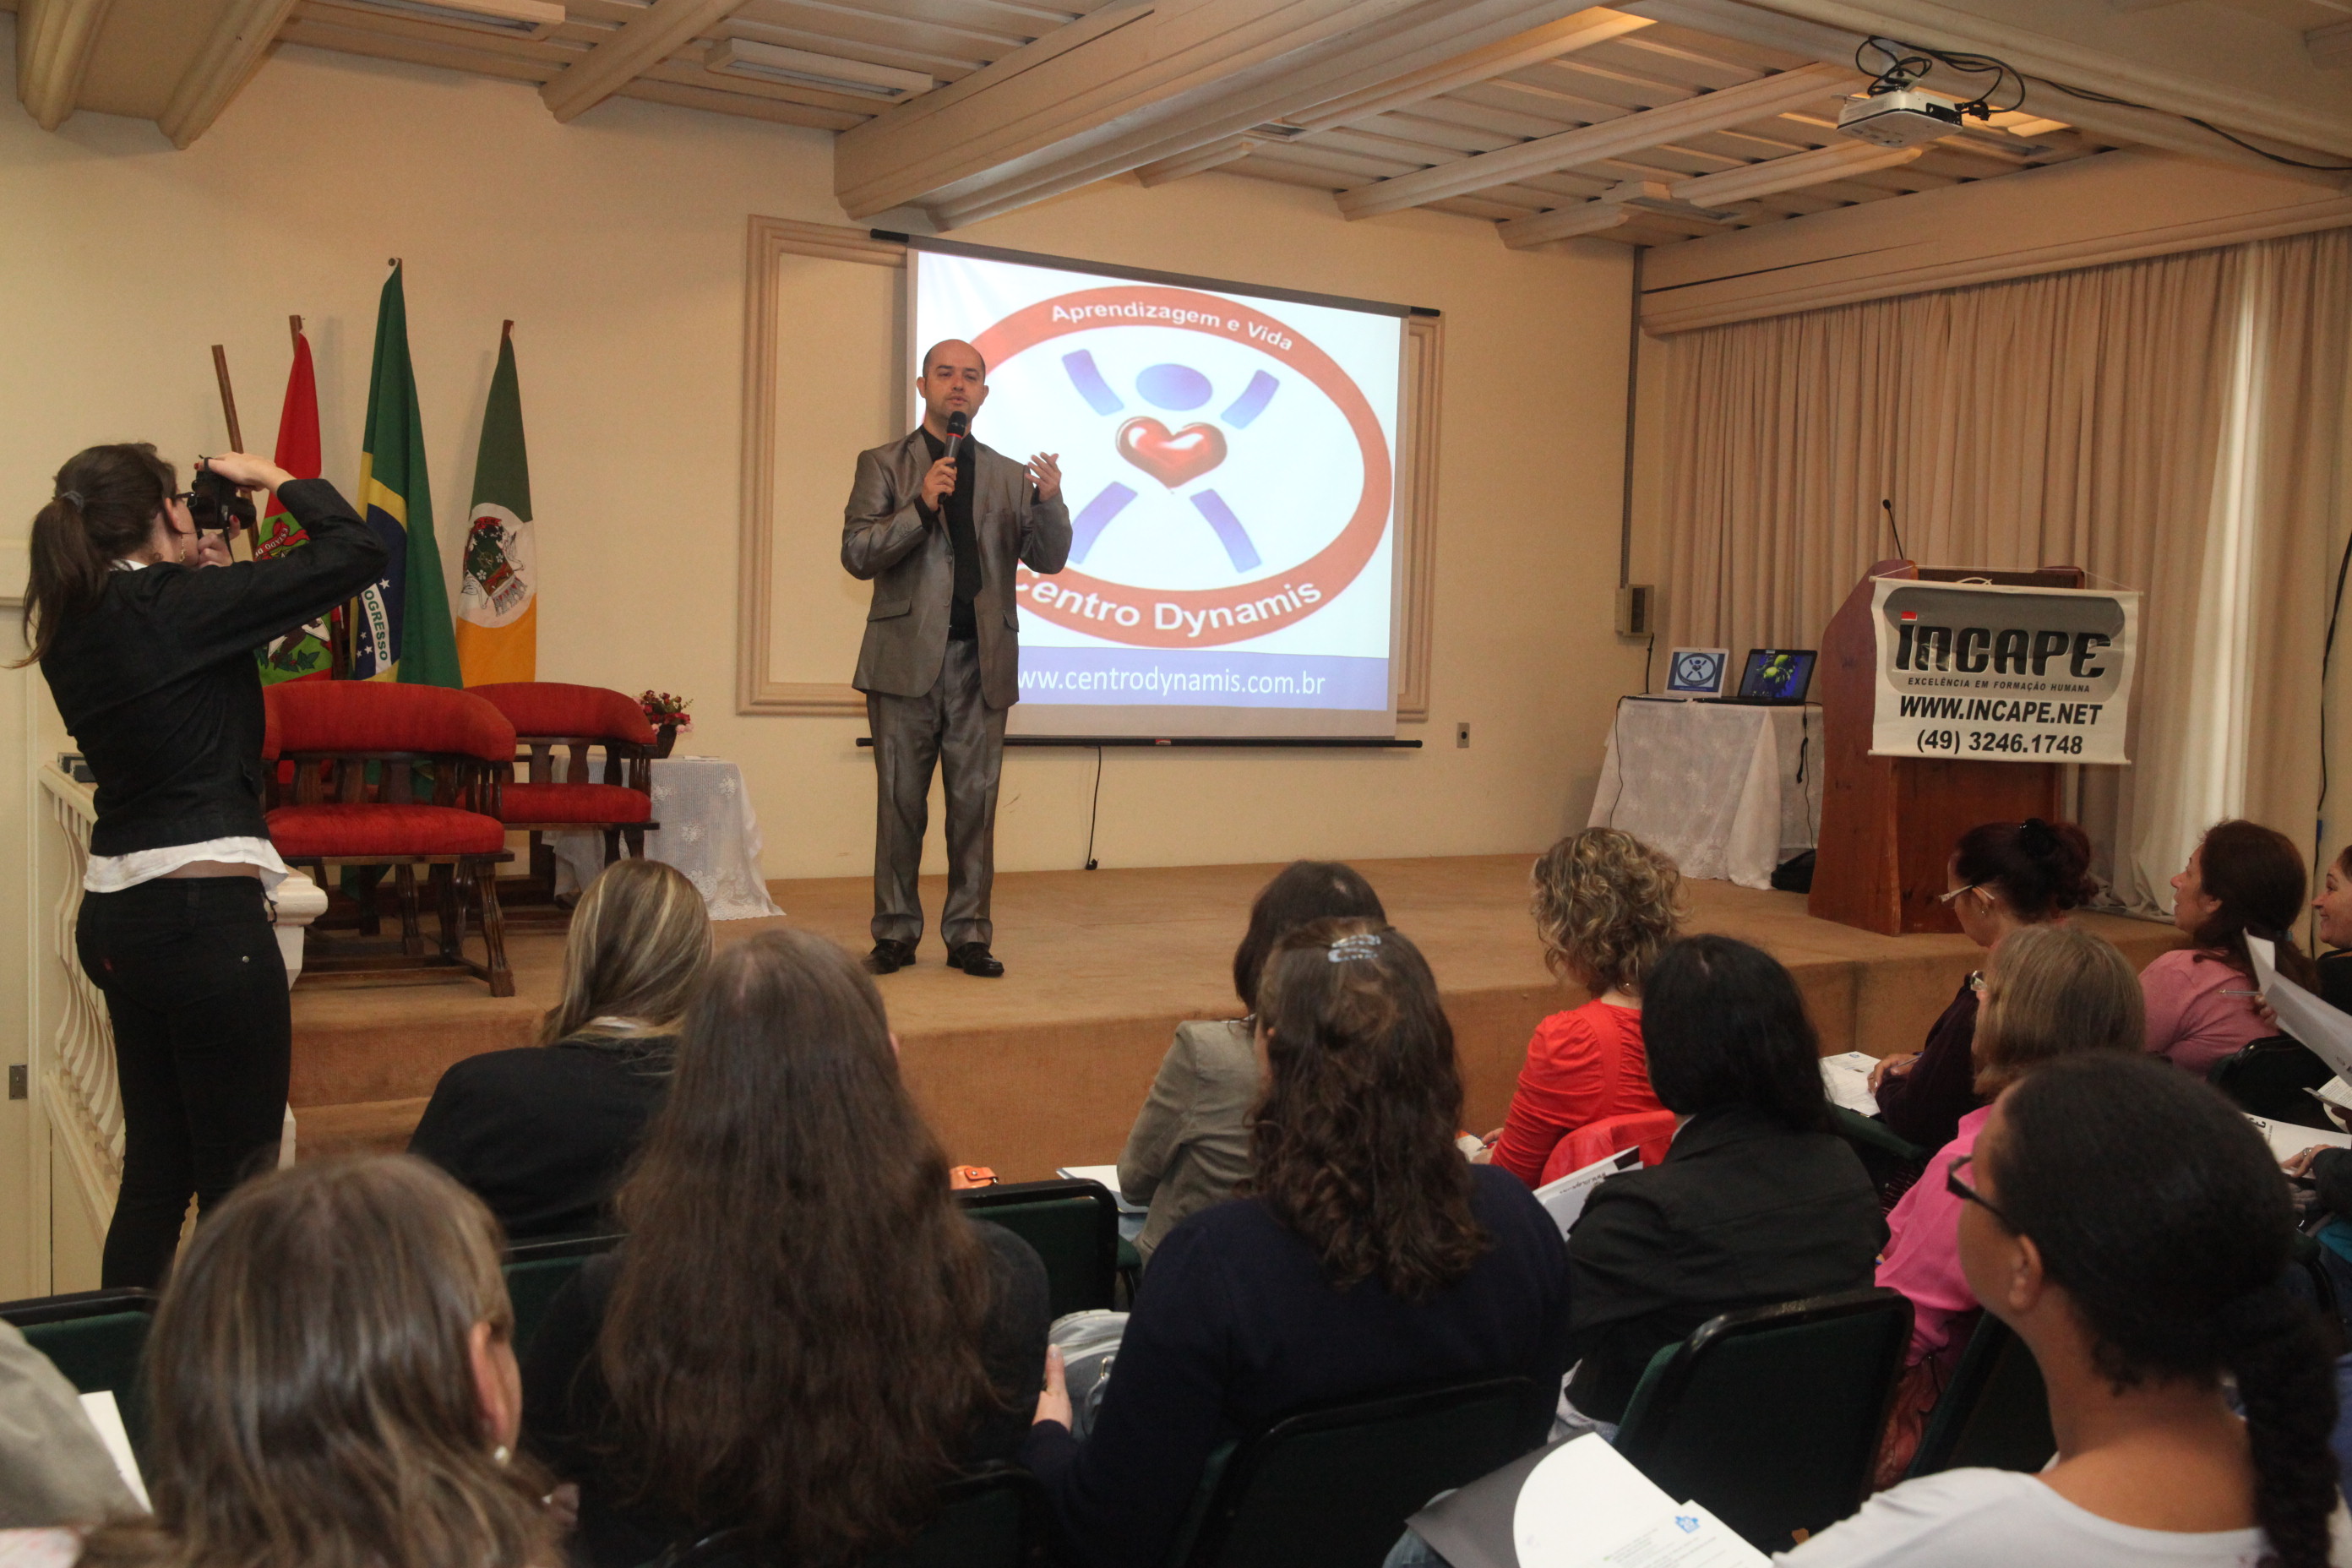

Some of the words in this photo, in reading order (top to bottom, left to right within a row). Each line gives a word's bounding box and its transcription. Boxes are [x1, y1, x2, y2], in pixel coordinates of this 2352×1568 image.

[1052, 301, 1221, 328] Aprendizagem
[1227, 318, 1240, 331] e
[1247, 321, 1293, 351] Vida
[264, 526, 289, 551] ESTADO
[1154, 581, 1322, 638] Dynamis
[364, 590, 388, 662] OGRESSO
[1017, 666, 1326, 697] ww.centrodynamis.com.br
[1908, 677, 1970, 688] EXCELÊNCIA
[1974, 679, 1989, 689] EM
[1993, 680, 2046, 692] FORMAÇÃO
[2050, 683, 2091, 694] HUMANA
[1900, 695, 2103, 726] WWW.INCAPE.NET
[1917, 729, 1961, 754] (49)
[1968, 731, 2083, 754] 3246.1748
